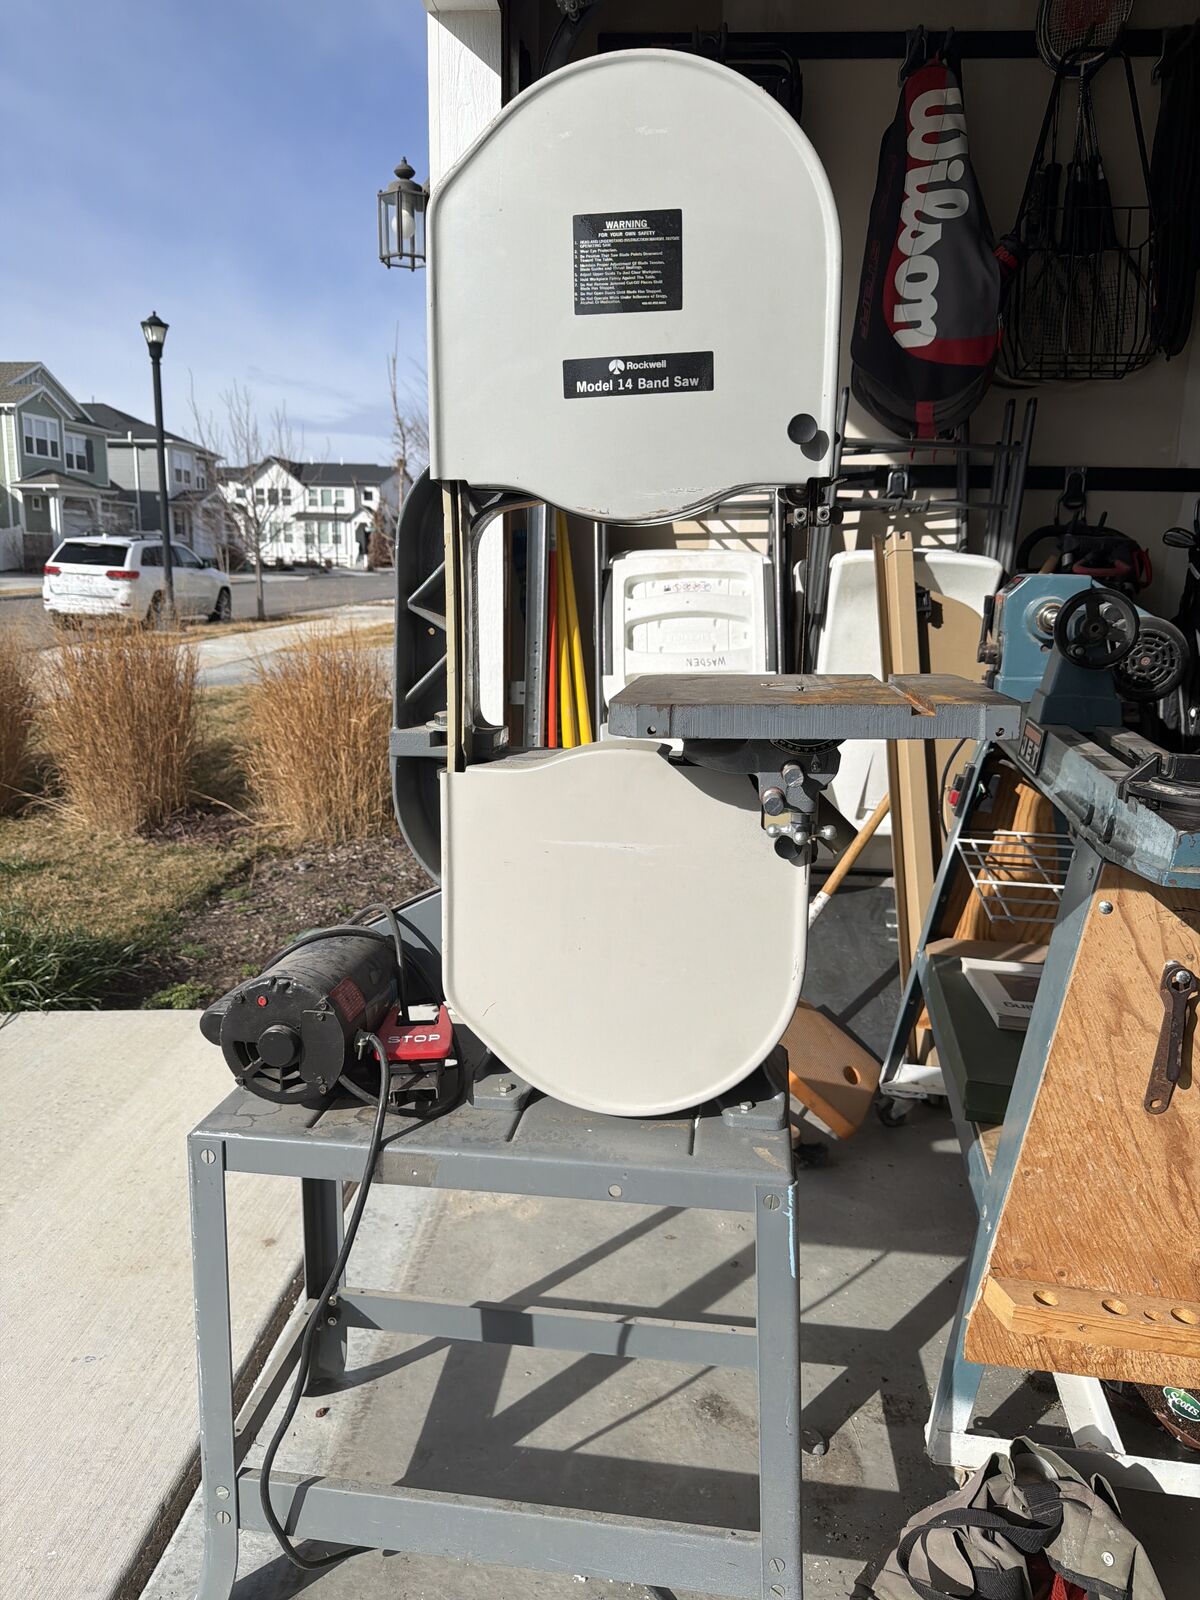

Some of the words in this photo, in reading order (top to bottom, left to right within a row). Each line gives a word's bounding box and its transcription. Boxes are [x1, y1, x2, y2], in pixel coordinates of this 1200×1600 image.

[605, 219, 648, 229] WARNING
[893, 87, 969, 349] Wilson
[626, 360, 666, 370] Rockwell
[576, 380, 612, 392] Model
[618, 378, 633, 390] 14
[638, 377, 669, 389] Band
[674, 376, 699, 388] Saw
[686, 656, 726, 667] WASDEN
[1020, 735, 1040, 770] JET
[388, 1033, 440, 1044] STOP
[1167, 1391, 1200, 1416] Scotts
